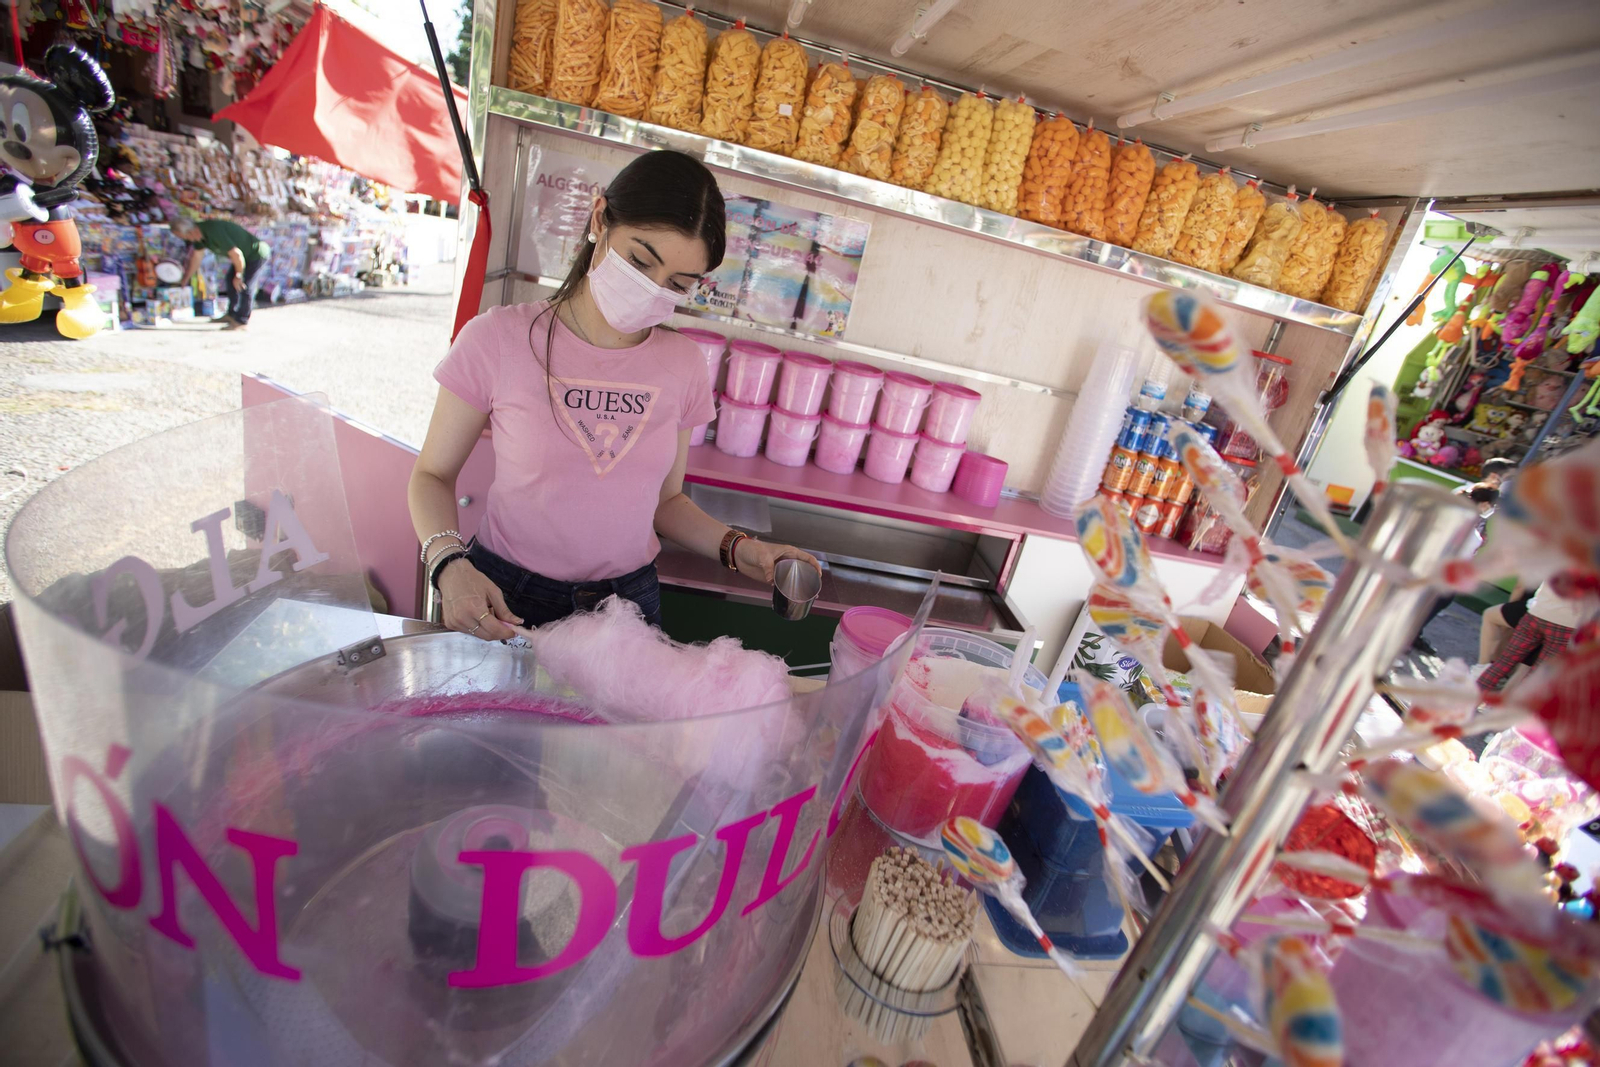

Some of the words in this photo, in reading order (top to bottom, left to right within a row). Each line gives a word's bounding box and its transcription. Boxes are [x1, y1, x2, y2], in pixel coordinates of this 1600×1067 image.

[725, 209, 777, 231] GODÓN
[564, 389, 645, 414] GUESS
[577, 419, 596, 443] WASHED
[621, 425, 634, 441] JEANS
